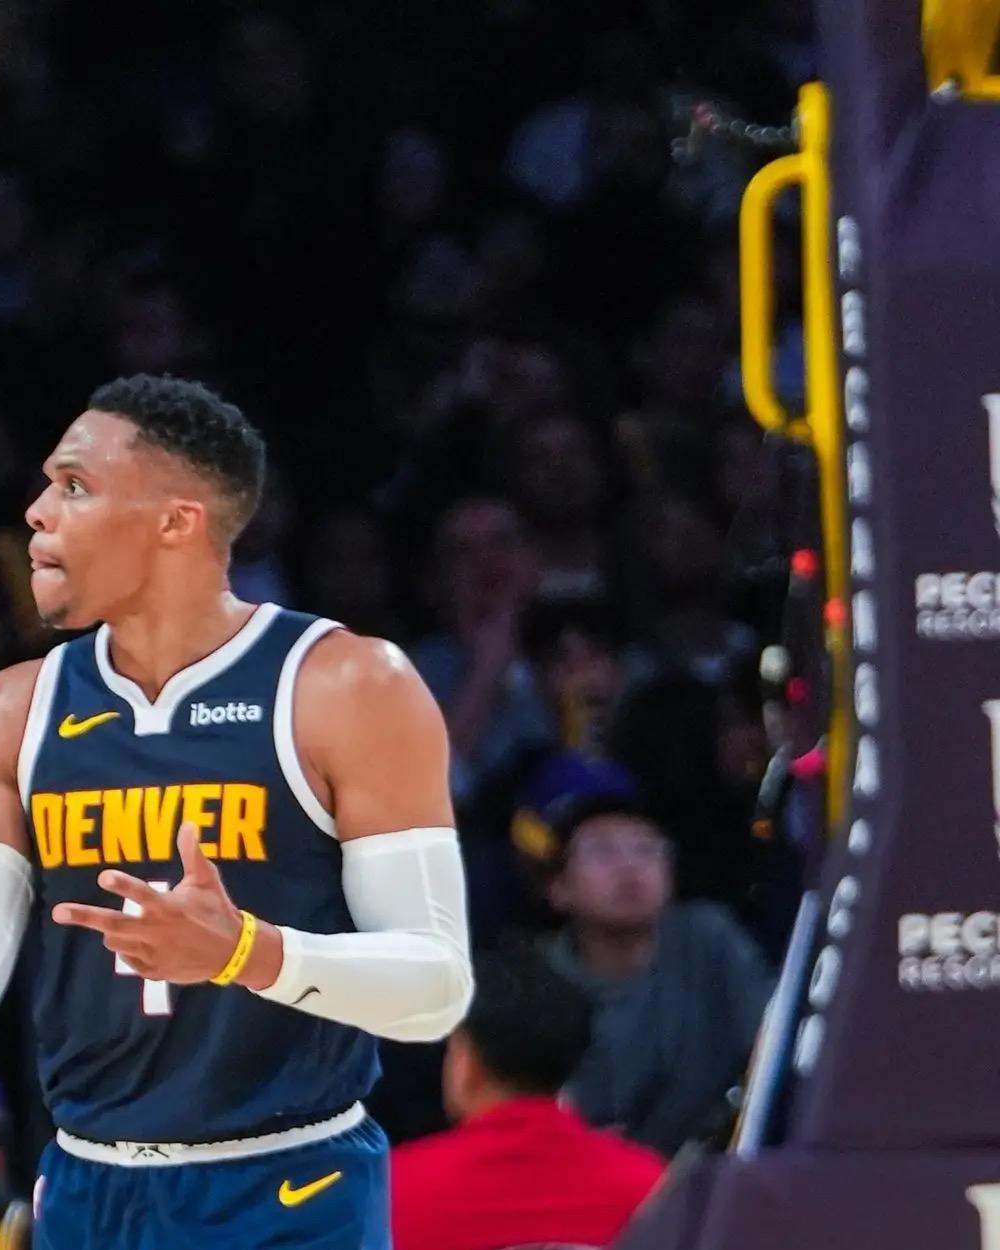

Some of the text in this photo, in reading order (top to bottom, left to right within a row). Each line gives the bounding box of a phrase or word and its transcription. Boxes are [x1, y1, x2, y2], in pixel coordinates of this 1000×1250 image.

[915, 571, 1000, 608] PEC
[189, 702, 263, 726] ibotta
[31, 783, 269, 869] DENVER
[898, 910, 1000, 956] PEC
